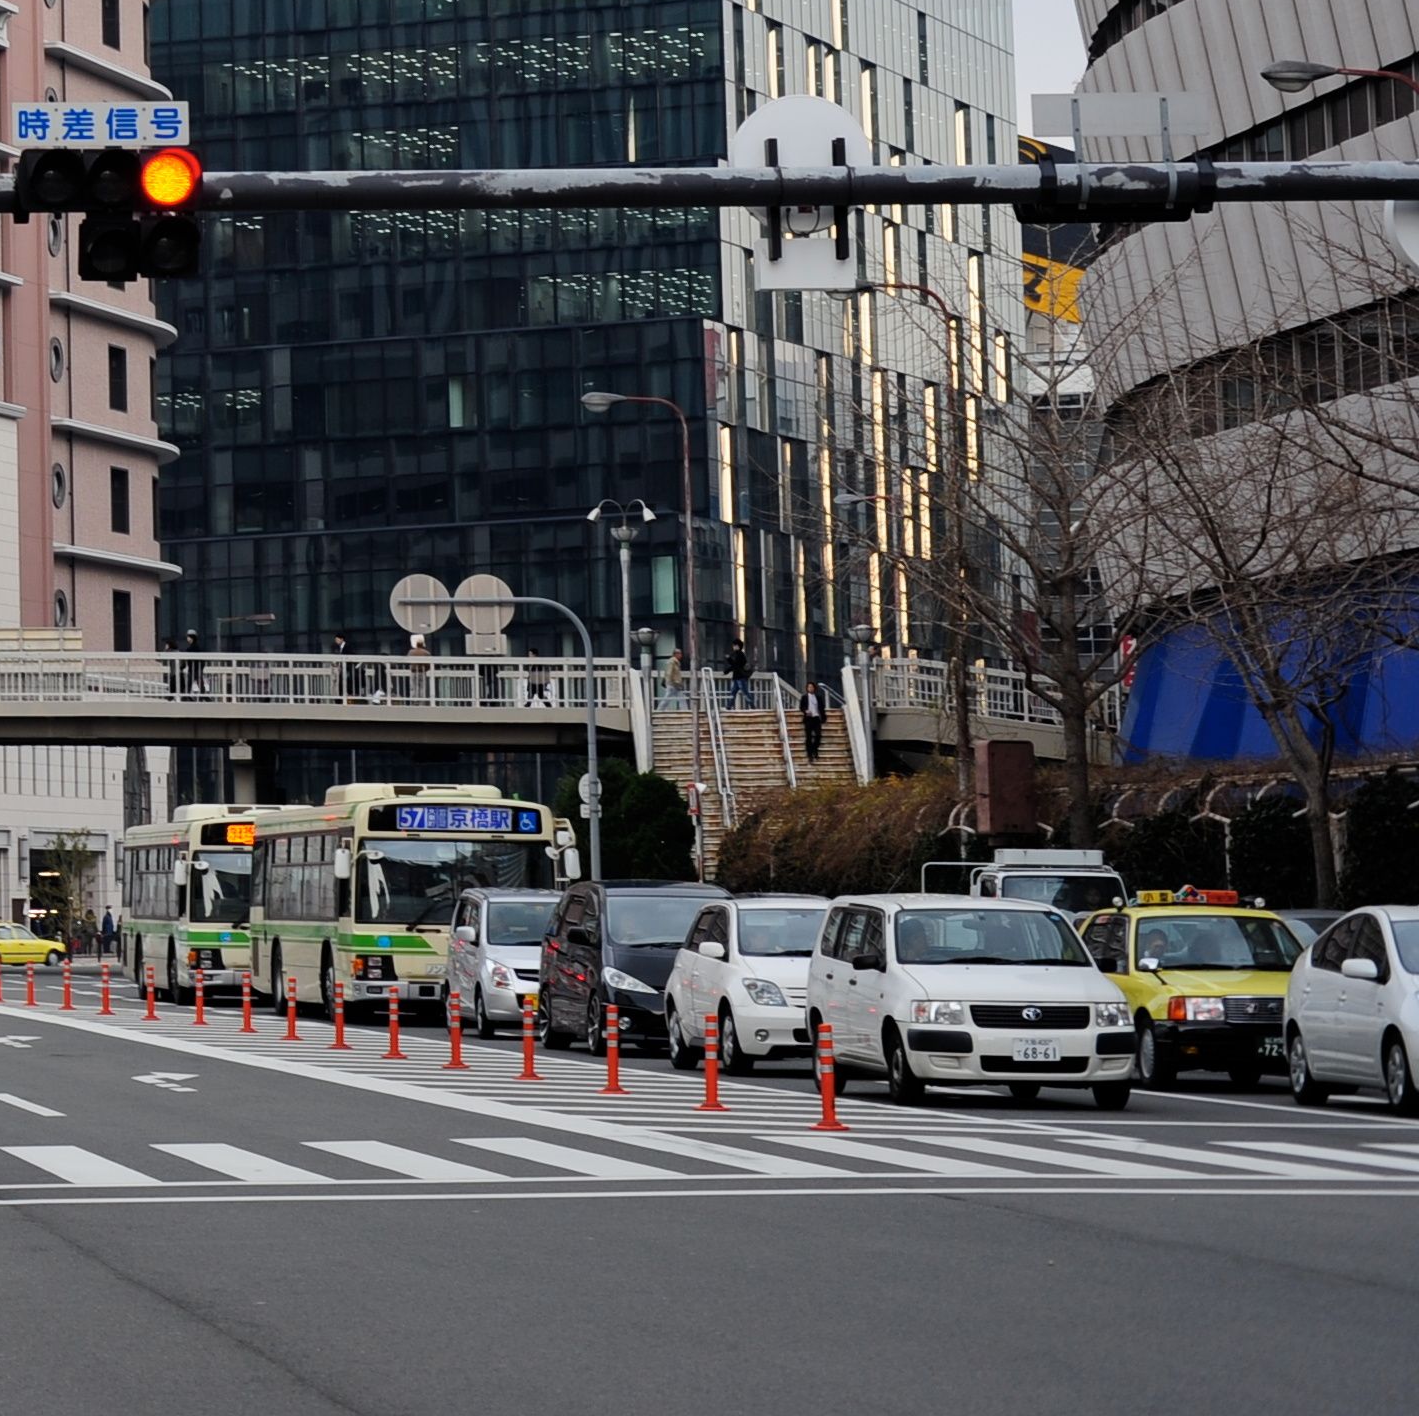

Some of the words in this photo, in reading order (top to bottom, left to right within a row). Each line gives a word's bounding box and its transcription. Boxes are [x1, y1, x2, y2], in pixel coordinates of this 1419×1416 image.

[16, 107, 184, 142] 時差信号
[400, 808, 425, 828] 57
[449, 808, 510, 830] 京橋駅
[1023, 1046, 1056, 1059] 68-61
